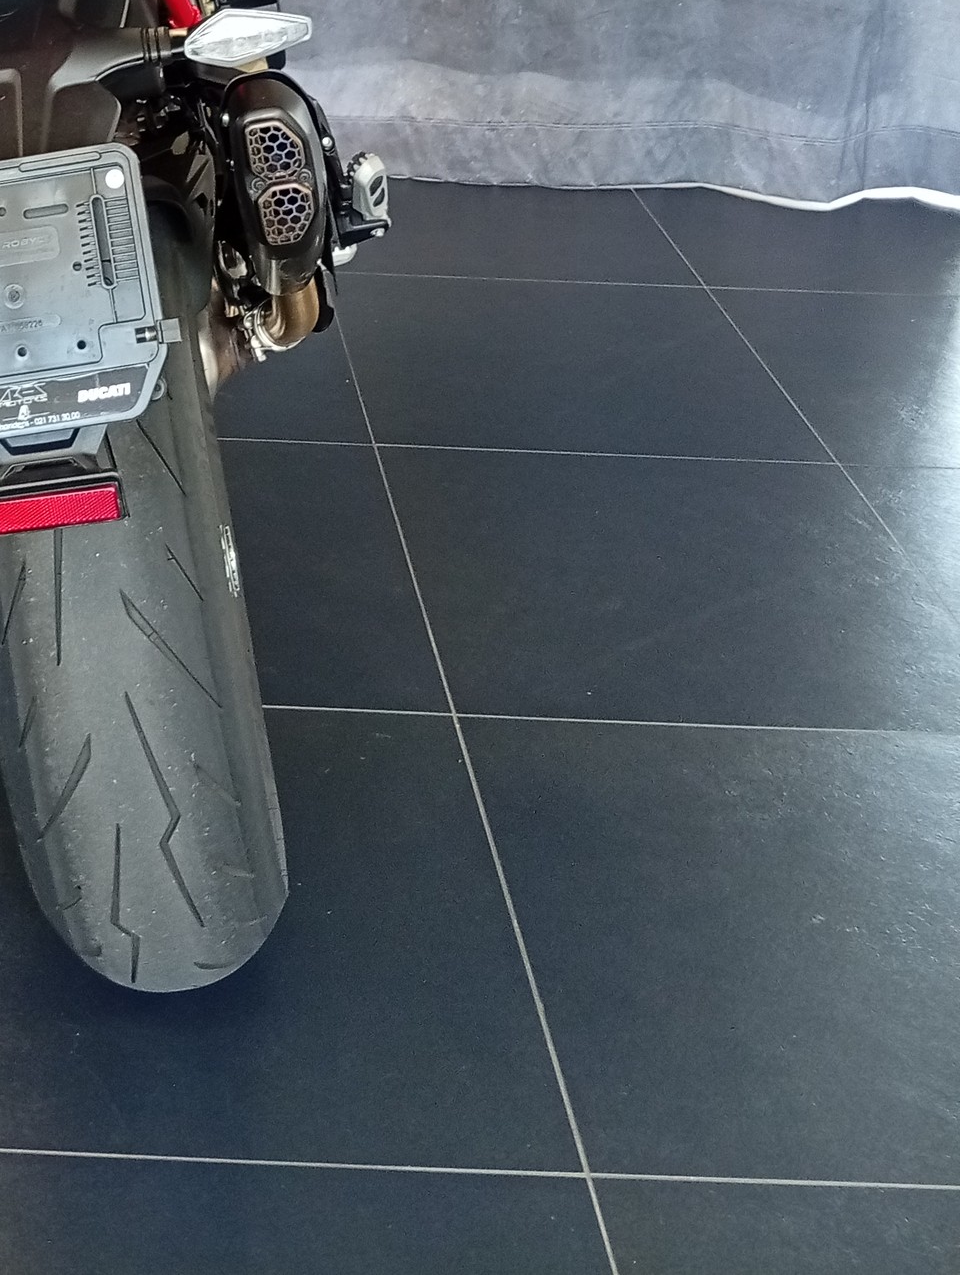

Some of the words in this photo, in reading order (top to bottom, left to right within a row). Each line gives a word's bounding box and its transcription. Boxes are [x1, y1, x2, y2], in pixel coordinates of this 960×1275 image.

[77, 382, 131, 403] DUCATI
[34, 416, 48, 425] 021
[48, 414, 61, 424] 731
